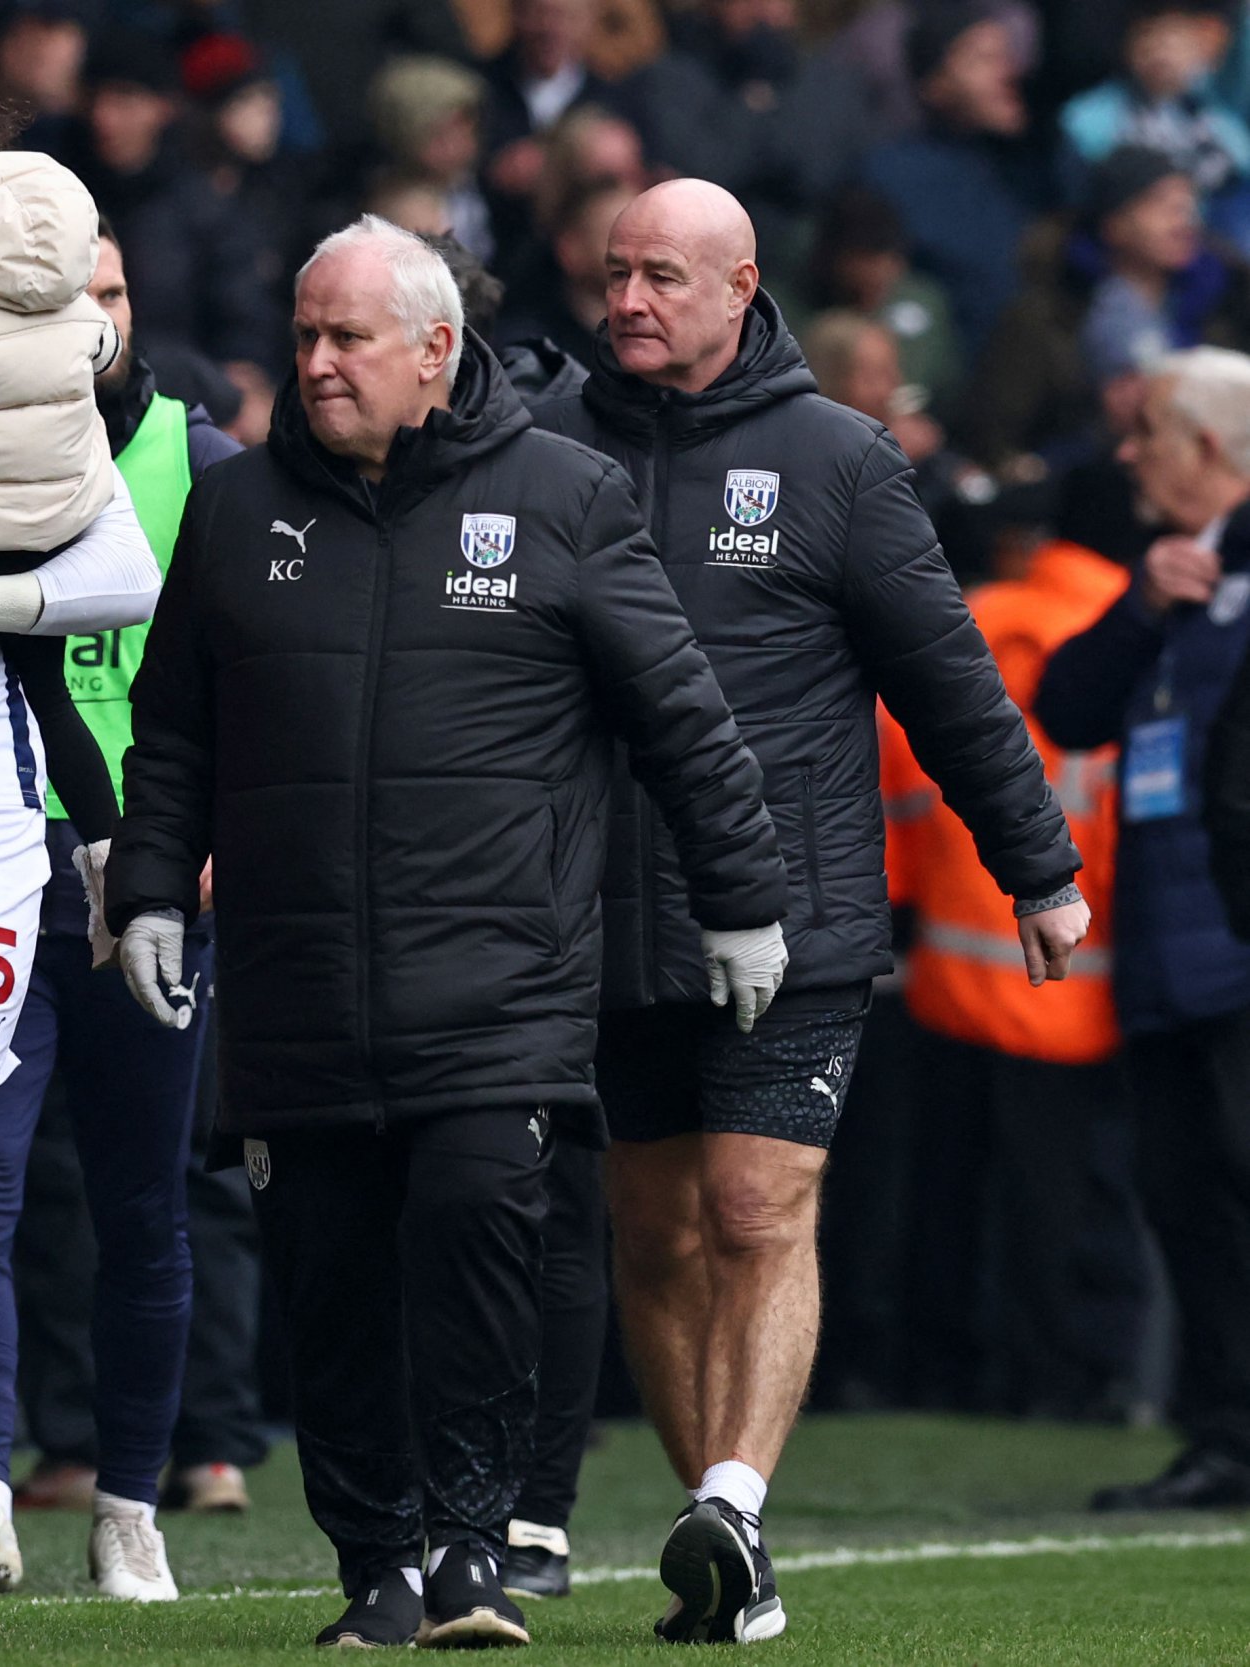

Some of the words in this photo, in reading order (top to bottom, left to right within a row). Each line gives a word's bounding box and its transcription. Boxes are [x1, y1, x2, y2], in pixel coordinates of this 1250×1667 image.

[730, 478, 774, 490] ALBION
[467, 522, 509, 533] ALBION
[709, 526, 779, 555] ideal
[267, 559, 304, 581] KC
[445, 570, 517, 599] ideal
[452, 596, 506, 607] HEATING
[824, 1056, 843, 1077] JS
